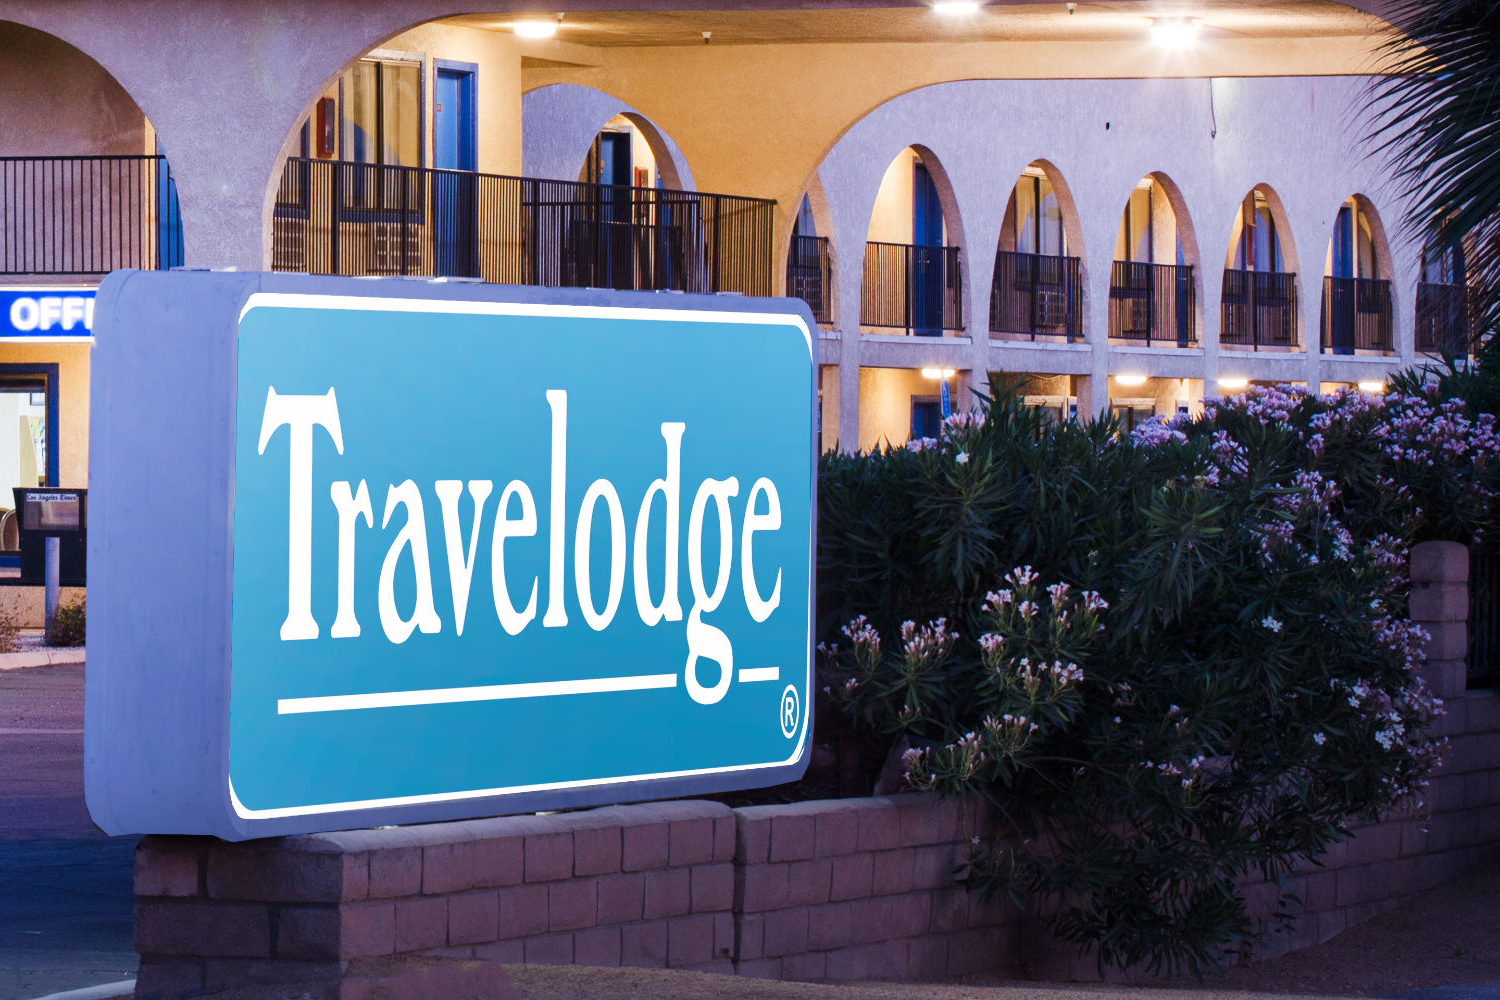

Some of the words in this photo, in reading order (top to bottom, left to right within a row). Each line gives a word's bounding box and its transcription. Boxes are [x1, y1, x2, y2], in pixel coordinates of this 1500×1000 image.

[10, 297, 95, 331] OFFI
[39, 494, 59, 502] Angeles
[258, 385, 782, 705] Travelodge
